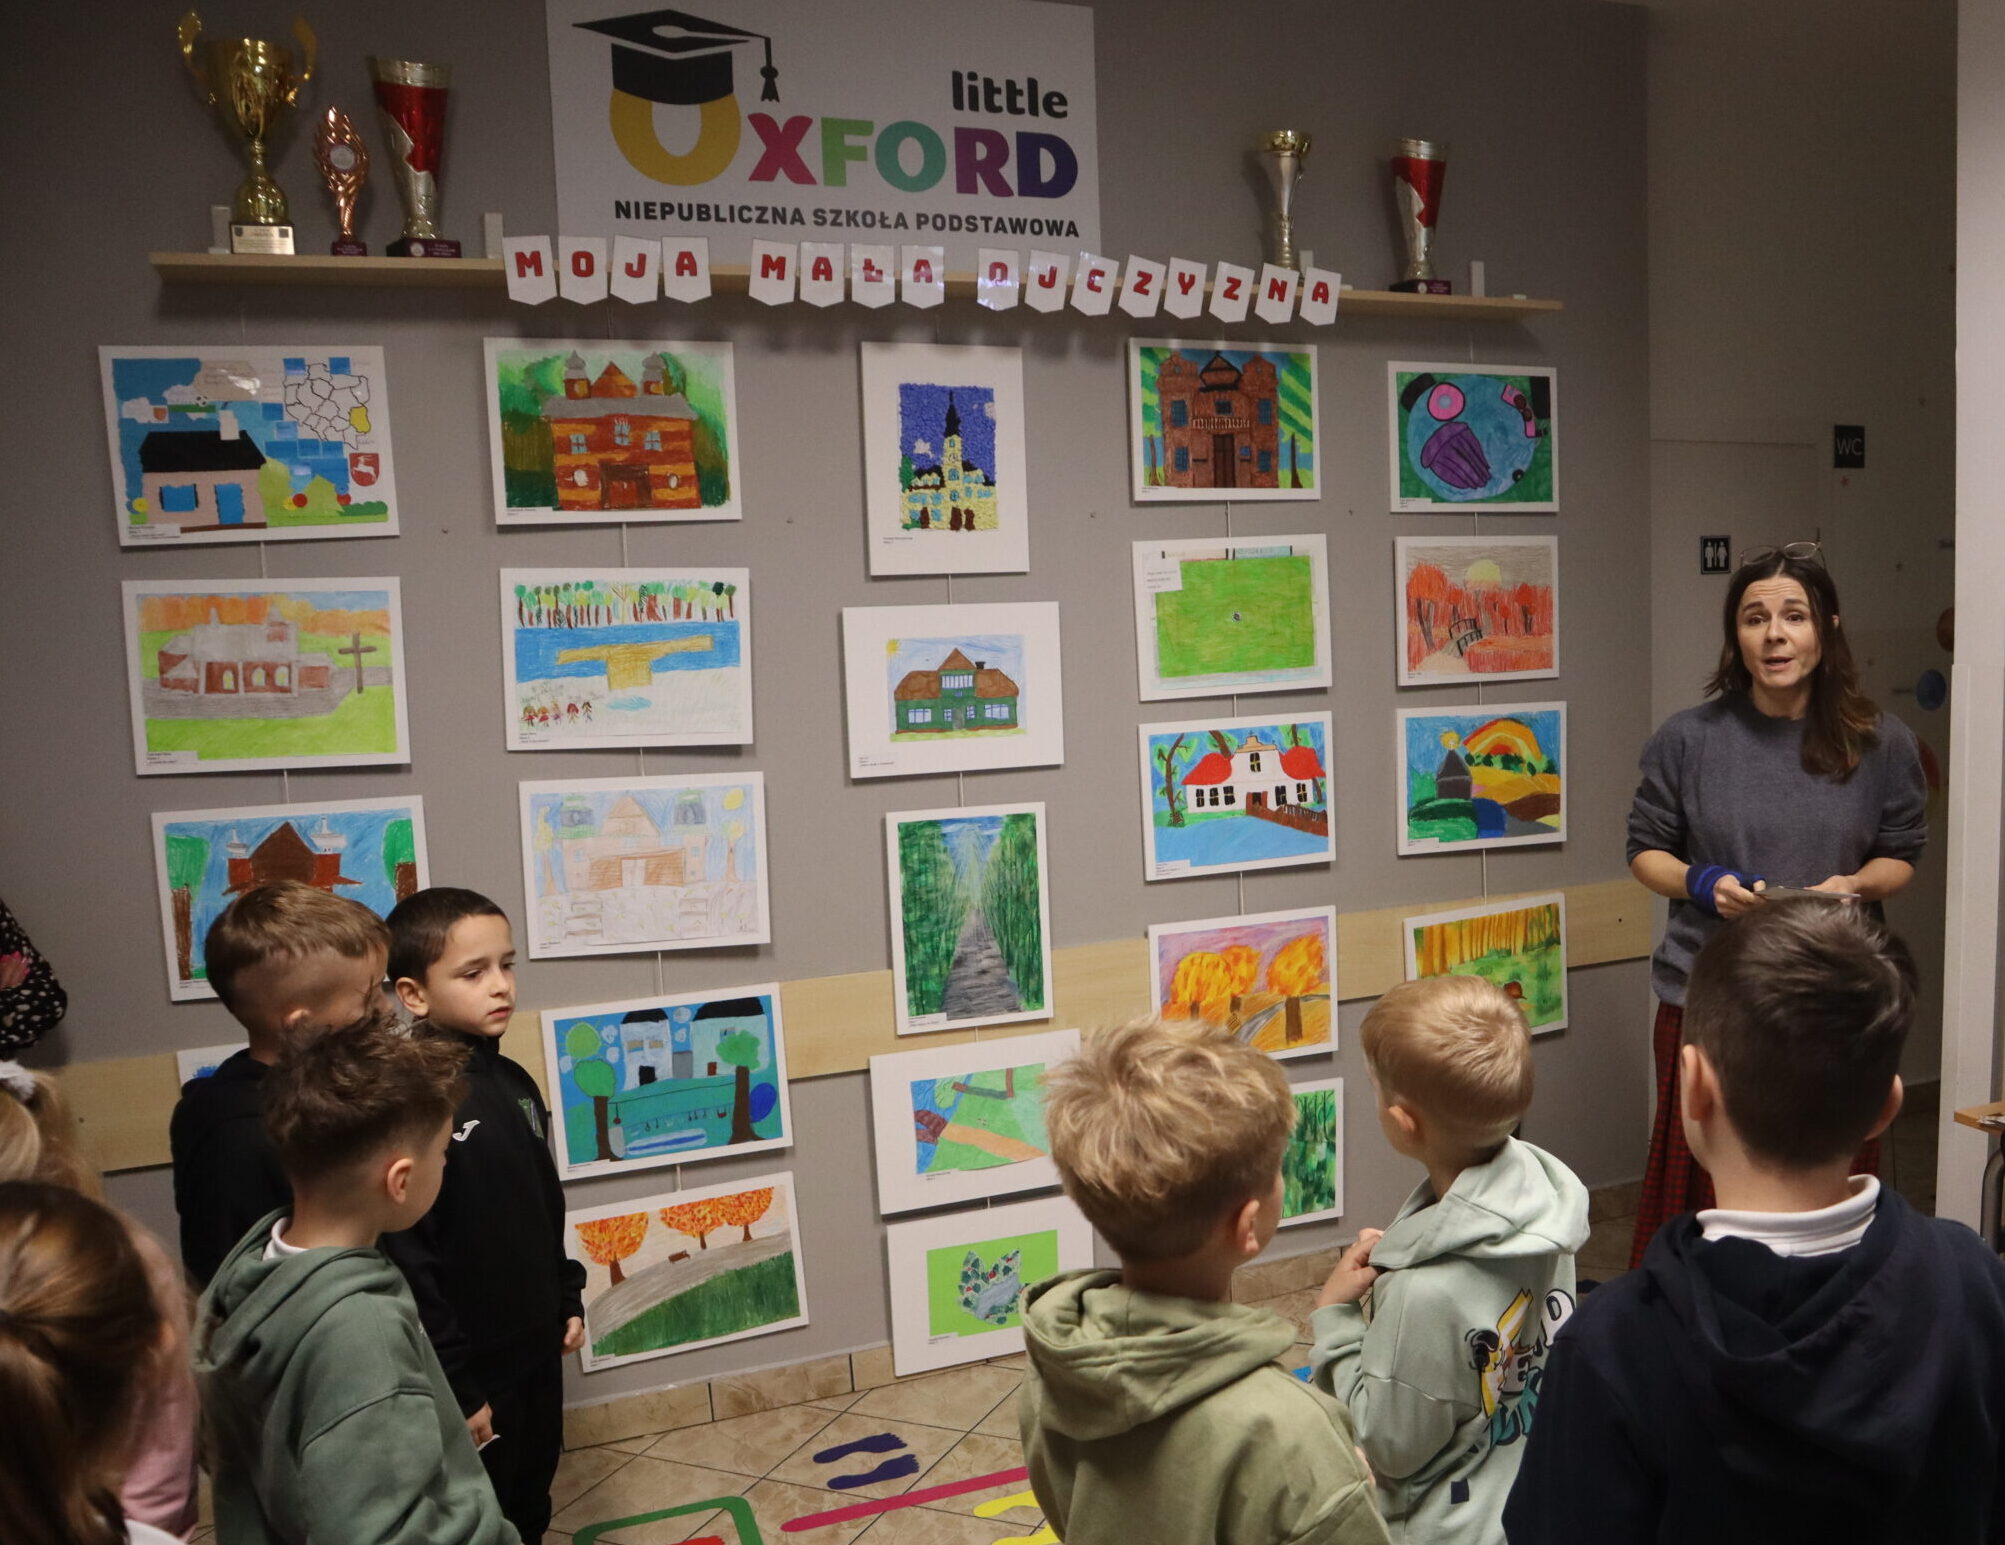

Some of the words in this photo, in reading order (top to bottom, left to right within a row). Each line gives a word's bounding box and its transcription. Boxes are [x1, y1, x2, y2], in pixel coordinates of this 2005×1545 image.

[951, 70, 1068, 119] little
[609, 88, 1079, 199] OXFORD
[614, 200, 806, 227] NIEPUBLICZNA
[813, 208, 909, 230] SZKOŁA
[916, 212, 1080, 238] PODSTAWOWA
[515, 250, 698, 279] MOJA
[761, 254, 934, 284] MAŁA
[989, 261, 1330, 304] OJCZYZNA
[1836, 438, 1863, 456] WC
